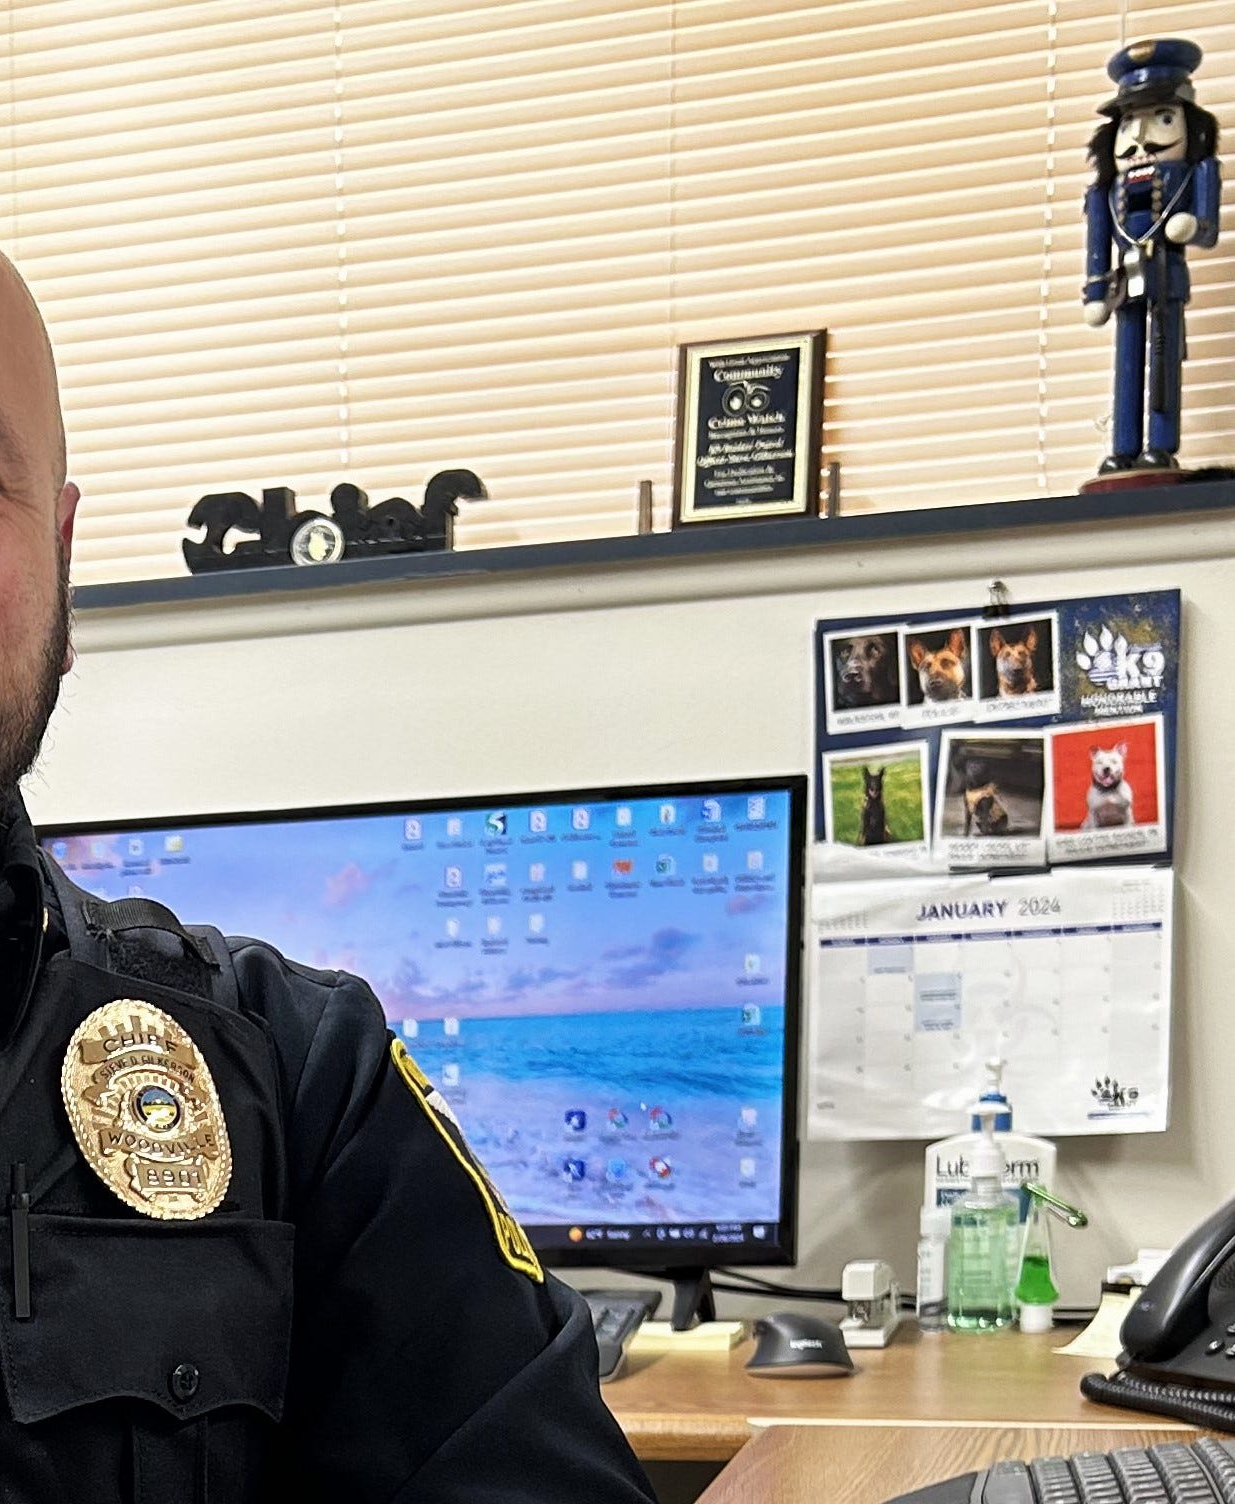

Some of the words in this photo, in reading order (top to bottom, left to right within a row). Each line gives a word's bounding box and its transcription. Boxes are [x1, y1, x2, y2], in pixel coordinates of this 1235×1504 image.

[916, 900, 1008, 922] JANUARY
[1018, 897, 1061, 916] 2024
[108, 1132, 215, 1154] WOODVILLE
